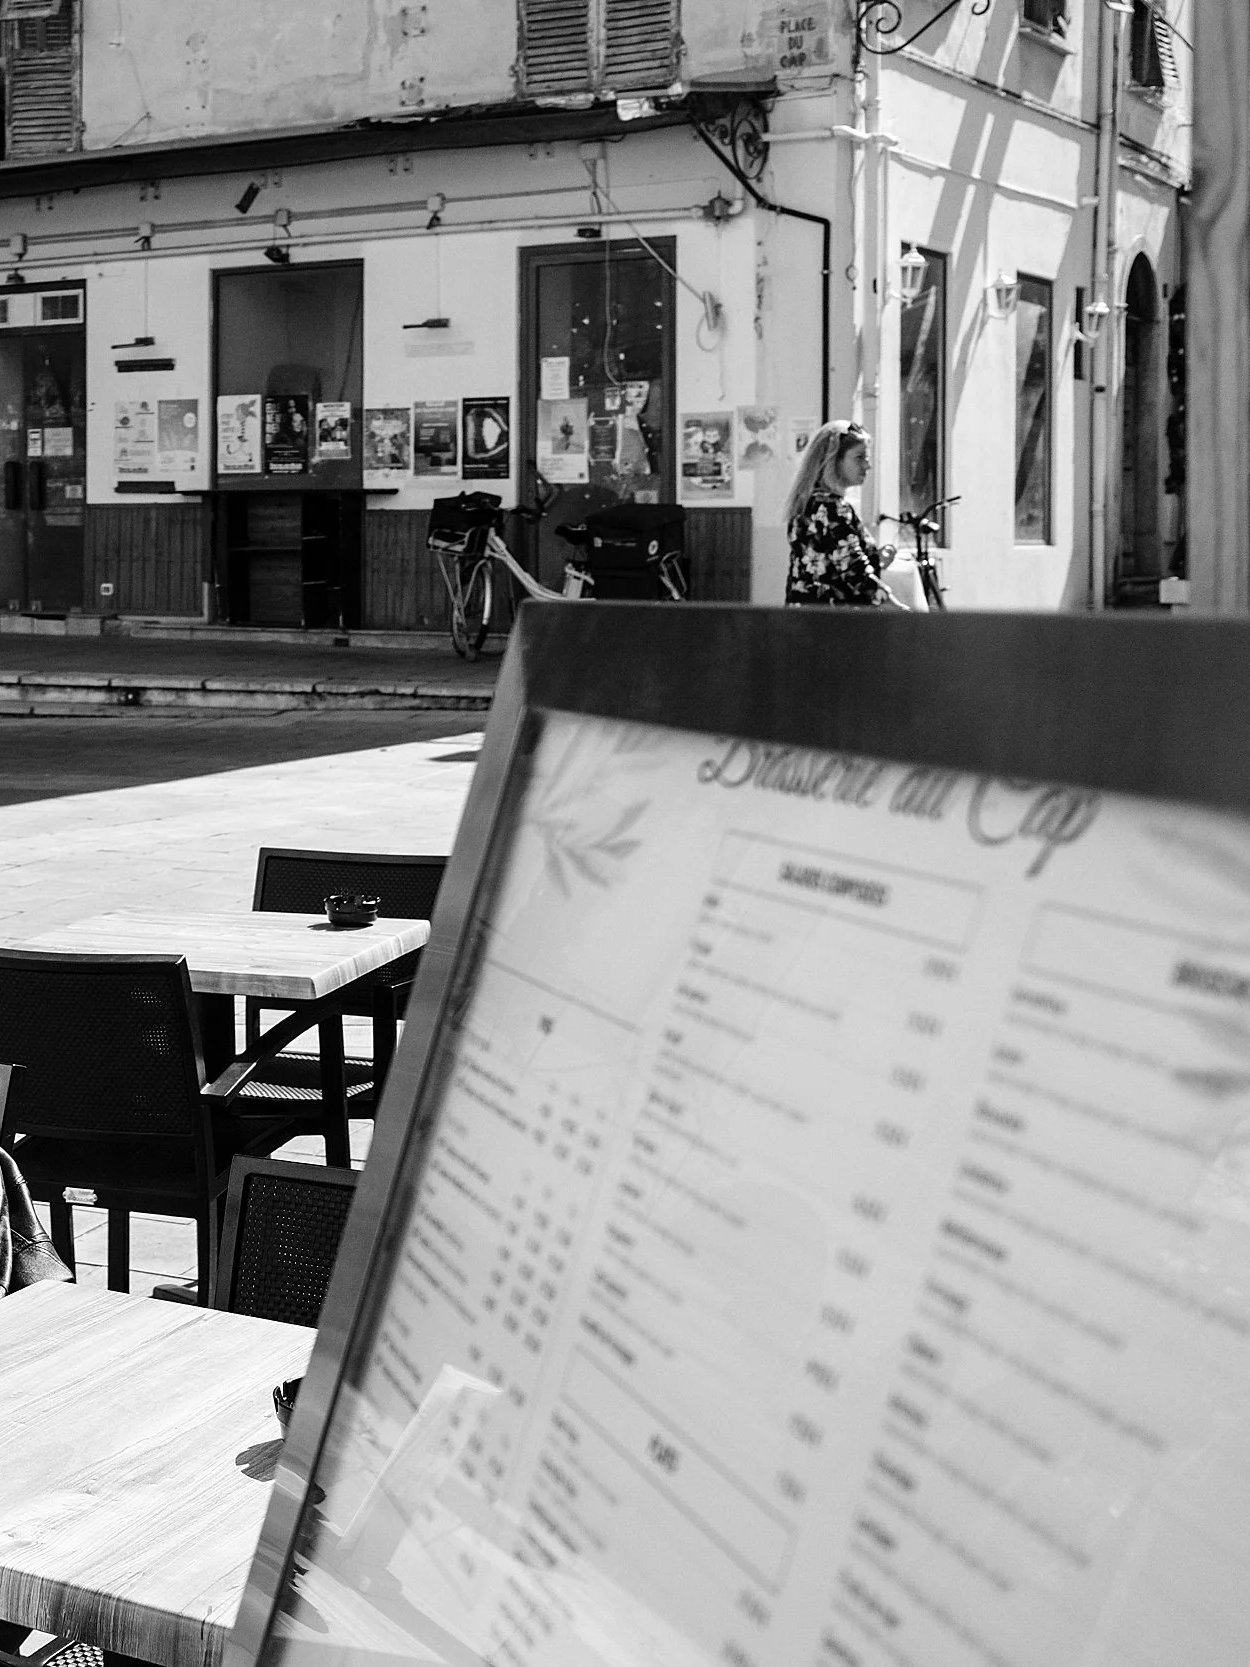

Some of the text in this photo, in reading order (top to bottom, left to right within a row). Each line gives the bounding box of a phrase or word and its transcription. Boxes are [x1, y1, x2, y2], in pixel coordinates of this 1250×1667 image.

[779, 16, 817, 34] PLACE
[788, 35, 804, 50] DU
[780, 51, 807, 68] CAP
[966, 772, 1103, 881] Cap
